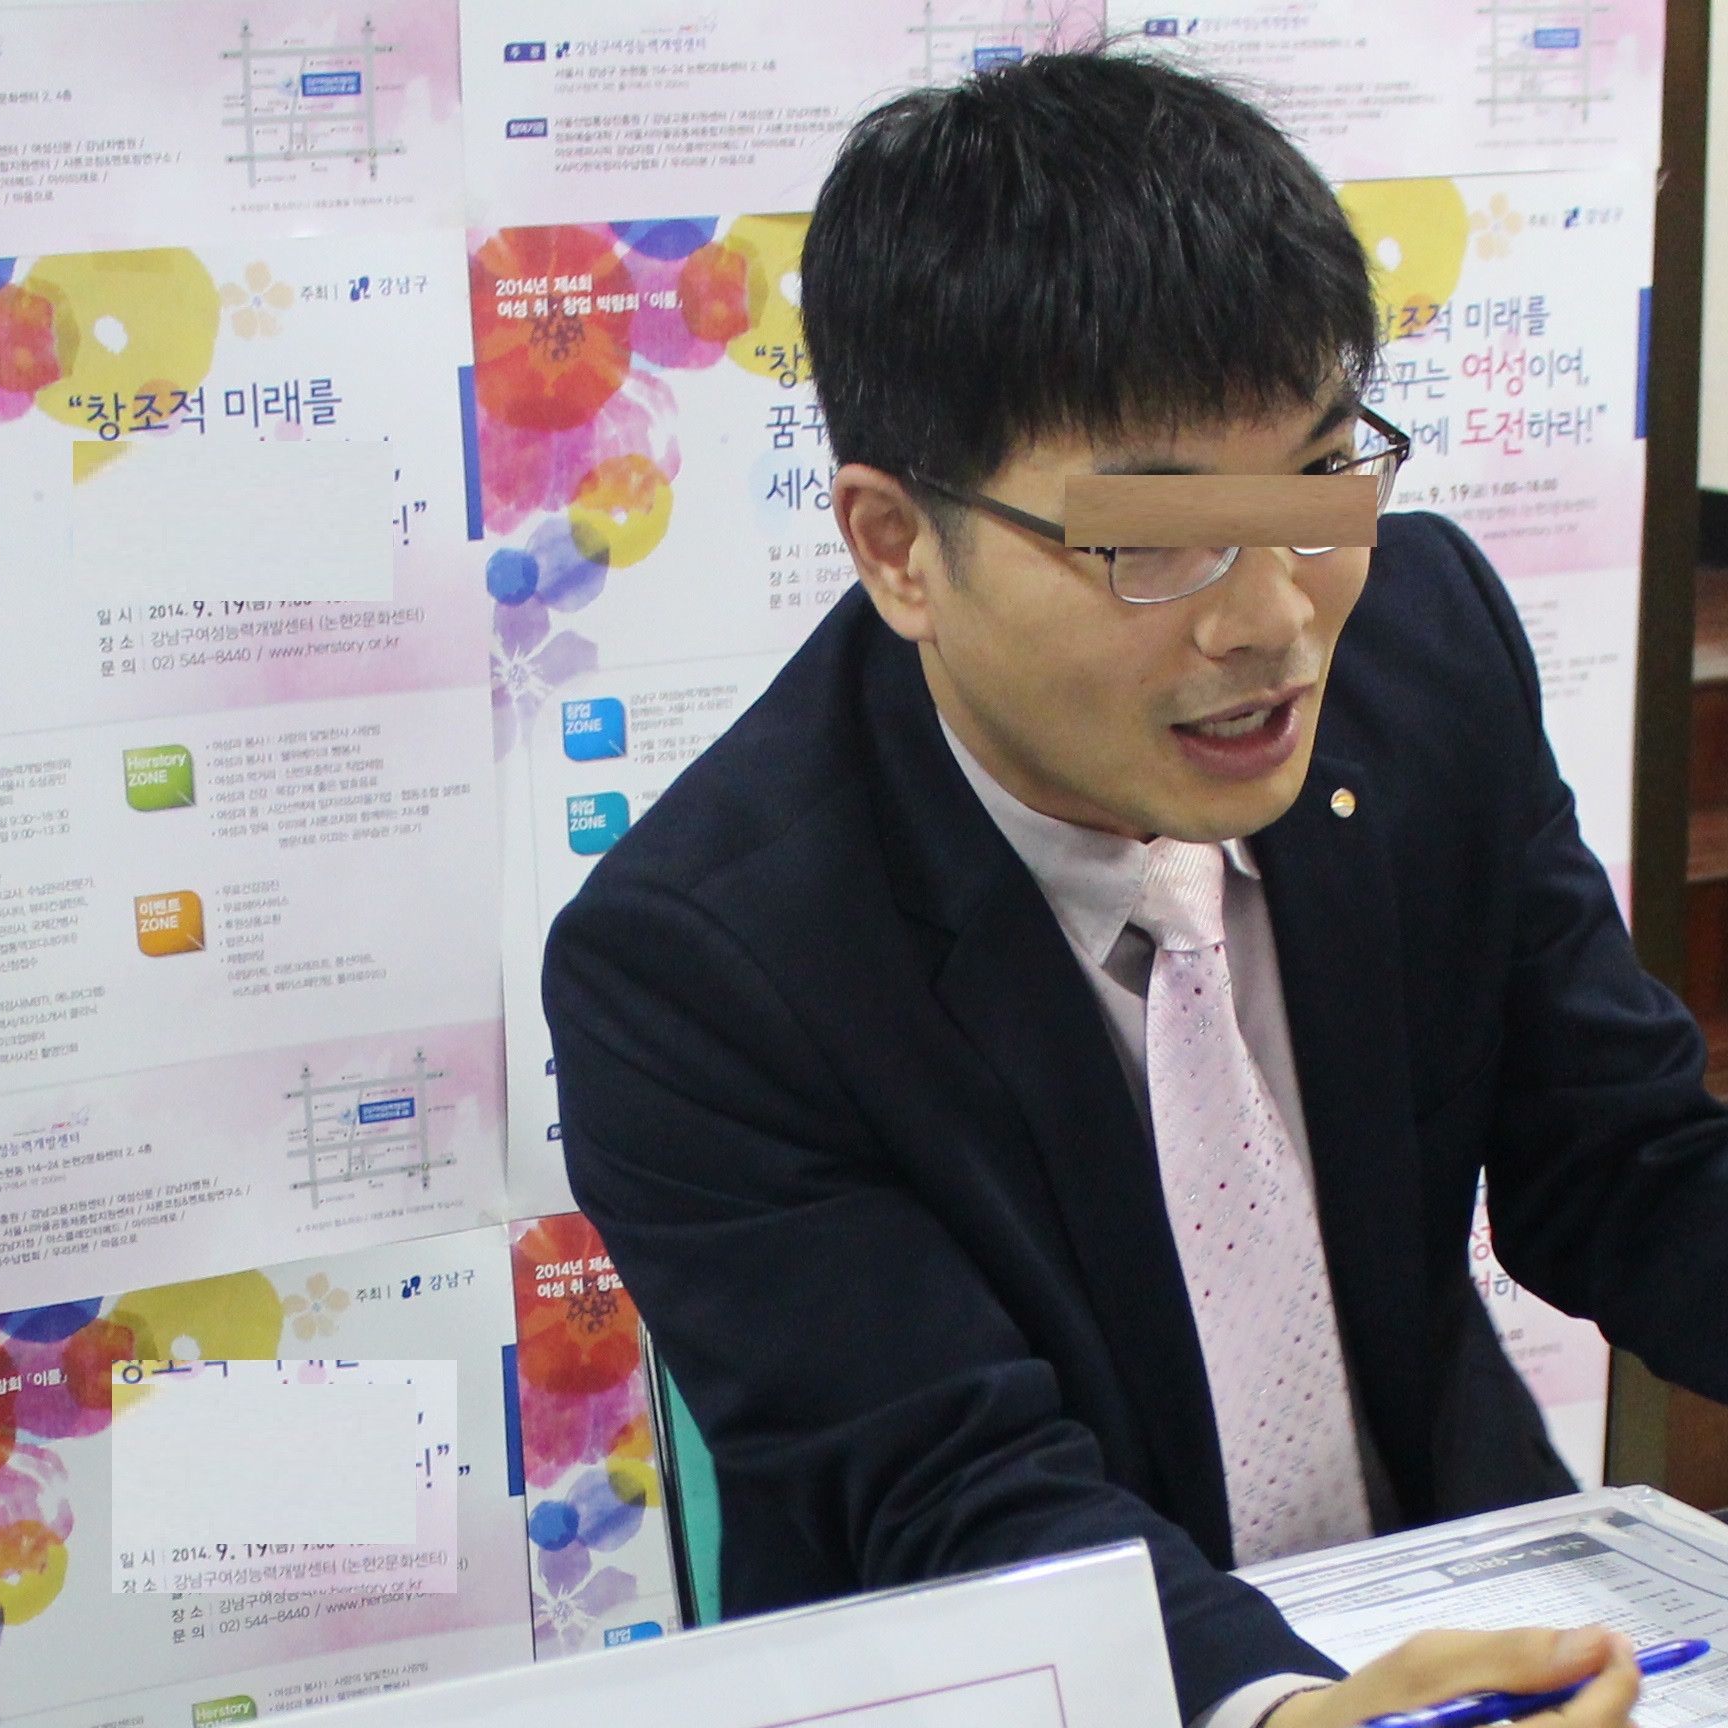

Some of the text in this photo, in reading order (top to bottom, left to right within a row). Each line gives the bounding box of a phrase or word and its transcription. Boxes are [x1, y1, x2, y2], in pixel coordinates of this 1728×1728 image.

[300, 276, 429, 302] 주최 강남구
[496, 274, 592, 296] 2014년 제4회
[497, 300, 528, 318] 여성
[534, 299, 548, 317] 취
[563, 296, 591, 316] 창업
[597, 293, 639, 312] 박람회
[1466, 295, 1551, 337] 미래를
[1462, 346, 1590, 396] 여성이여,
[225, 378, 342, 428] 미래를
[151, 617, 313, 647] 강남구여성능력개발센터
[320, 607, 424, 631] (논현2문화센터)
[566, 718, 602, 735] ZONE
[128, 754, 186, 770] Herstory
[128, 769, 167, 787] ZONE
[570, 815, 606, 832] ZONE
[140, 898, 181, 915] 이벤트
[141, 915, 178, 933] ZONE
[535, 1256, 614, 1280] 2014년 제4
[428, 1271, 476, 1292] 강남구
[537, 1281, 564, 1298] 여성
[571, 1278, 583, 1294] 취
[196, 1701, 250, 1721] Herstory
